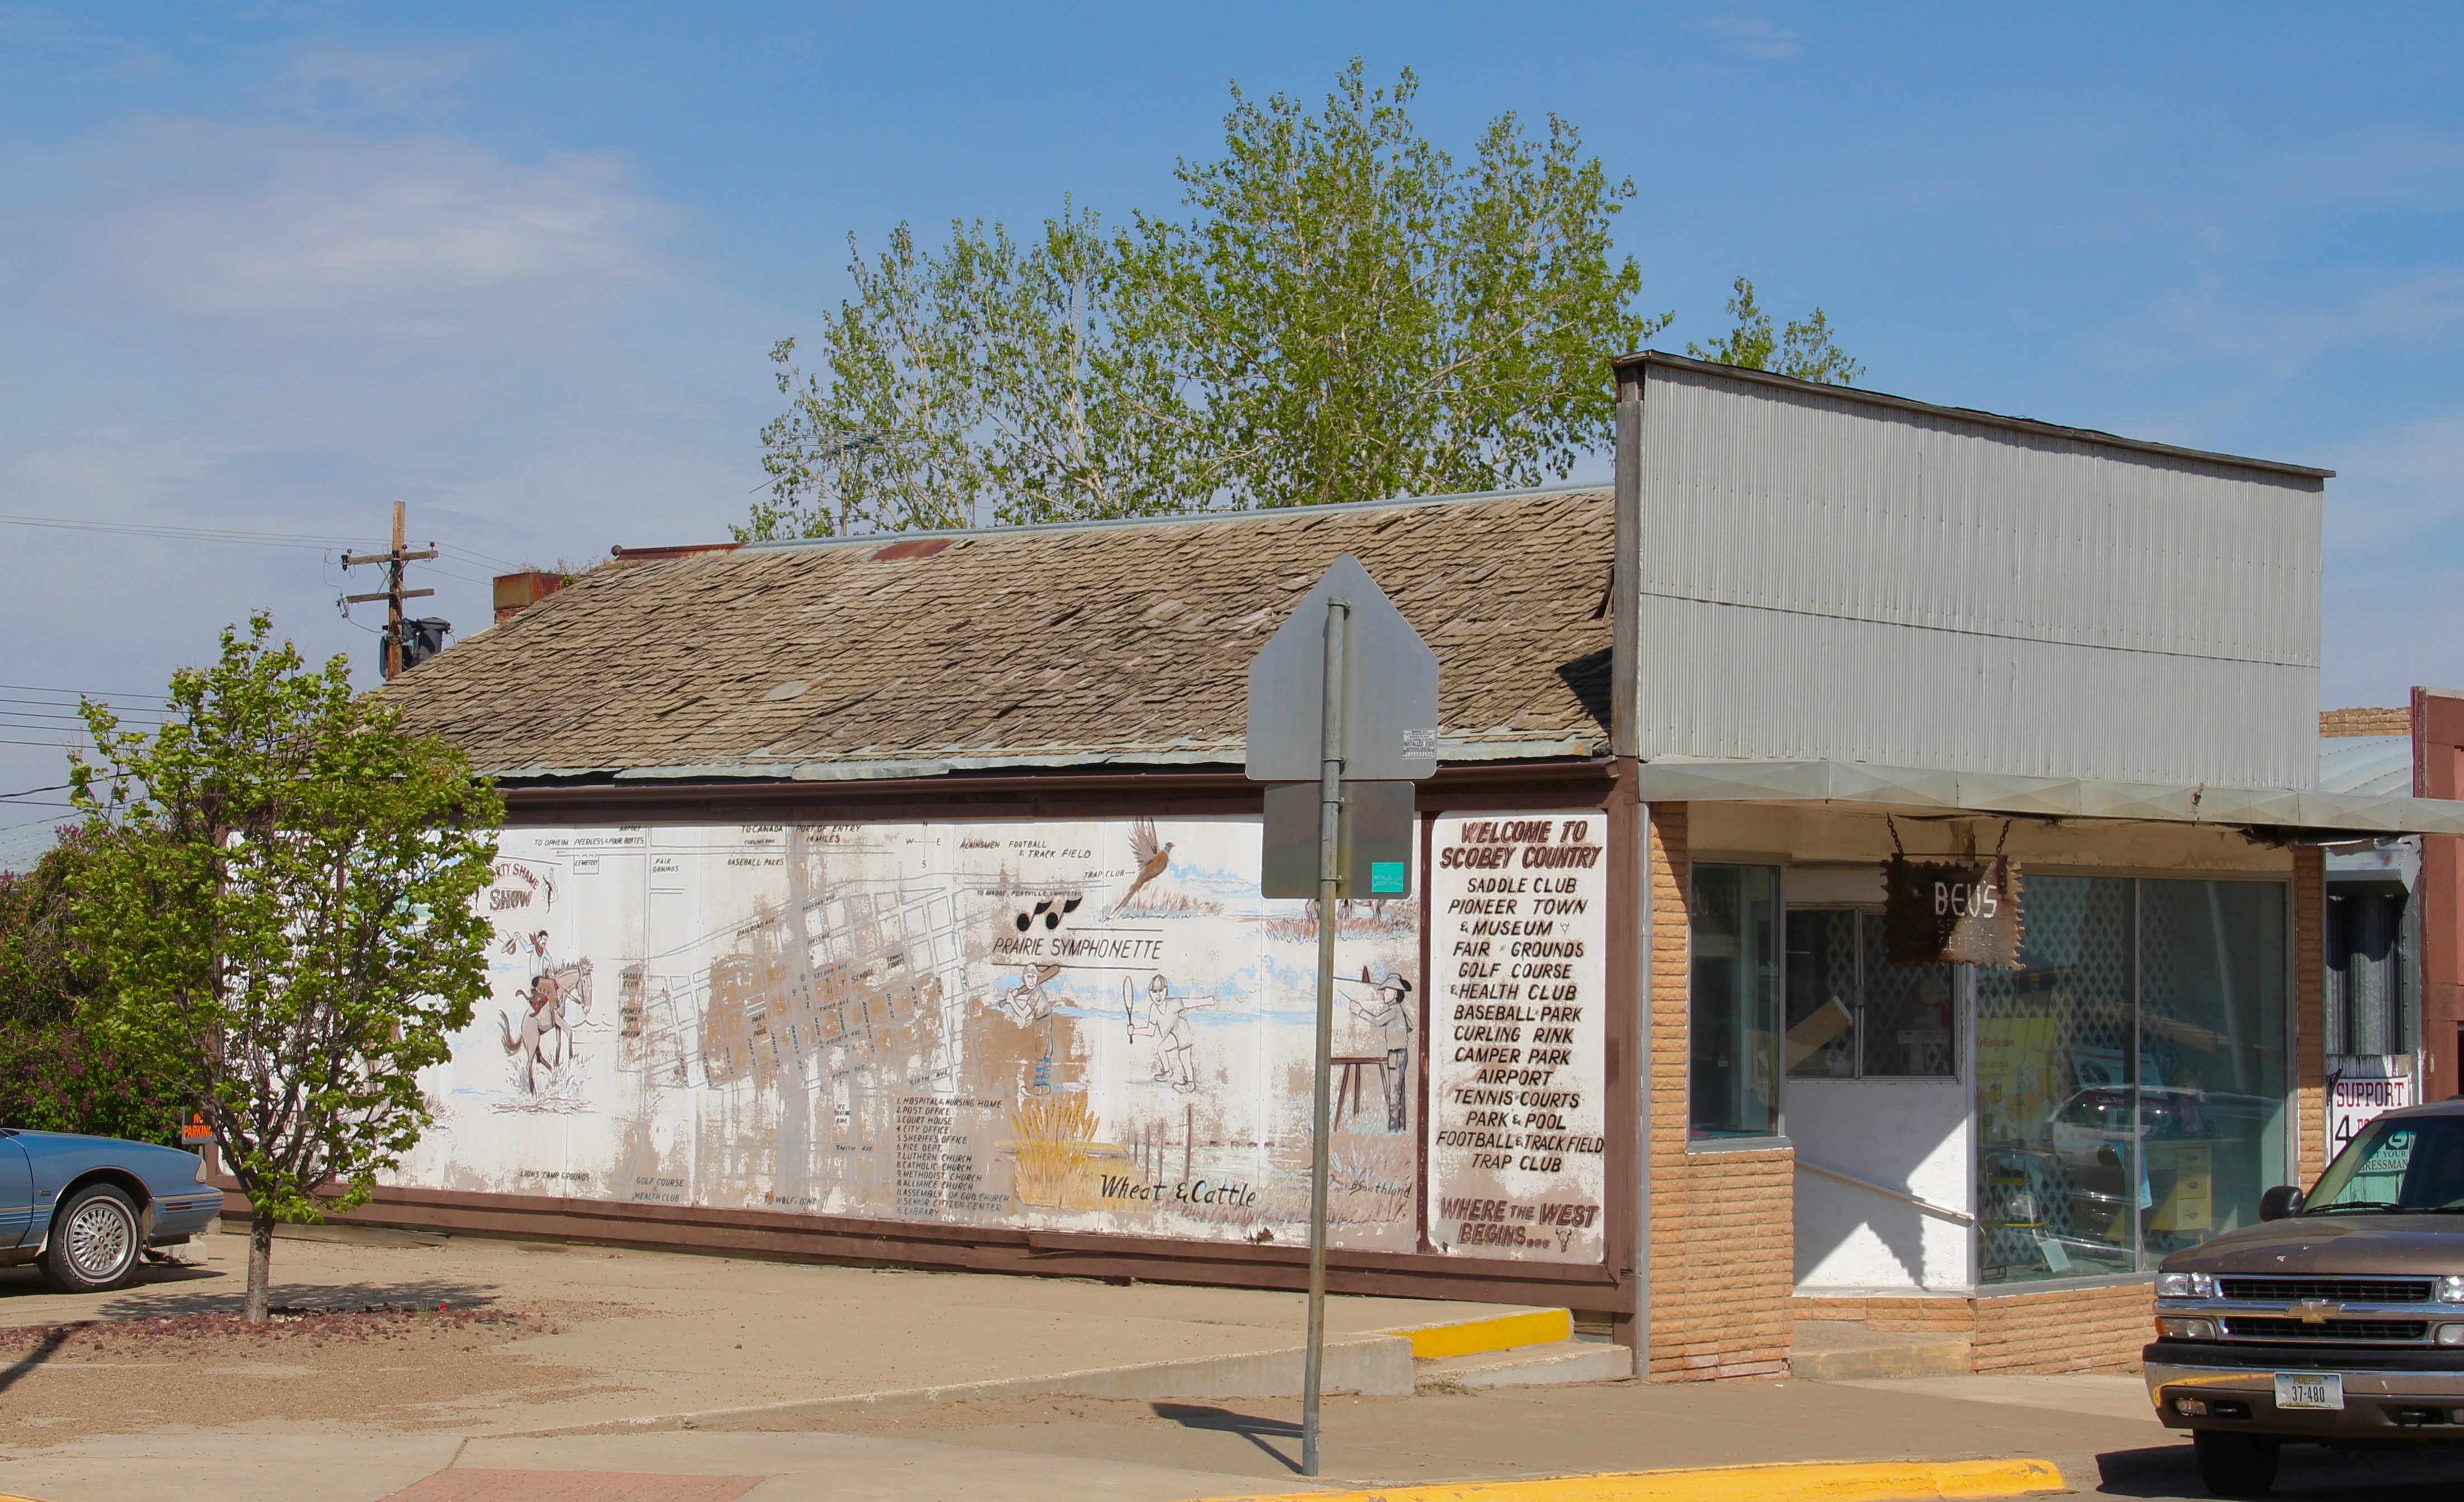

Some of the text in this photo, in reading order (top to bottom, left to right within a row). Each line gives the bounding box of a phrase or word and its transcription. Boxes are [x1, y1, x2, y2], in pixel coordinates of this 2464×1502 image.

[832, 824, 862, 833] ENTRY
[1462, 821, 1588, 843] WELCOME TO
[814, 835, 840, 843] MILES
[959, 840, 1047, 850] PLAINSMEN FOOTBALL
[1028, 850, 1057, 859] TRACK
[1062, 848, 1091, 859] FIELD
[1440, 846, 1604, 869] SCOBEY COUNTRY
[727, 857, 784, 866] BASEBALL PARKS
[922, 860, 927, 869] S
[513, 863, 540, 890] SHAME
[1467, 878, 1577, 893] SADDLE CLUB
[490, 889, 533, 911] SHOW
[1448, 899, 1588, 915] PIONEER TOWN
[736, 922, 764, 937] RAILROAD
[1460, 921, 1554, 936] & MUSEUM
[992, 938, 1163, 960] PRAIRIE SYMPHONETTE
[1453, 941, 1585, 957] FAIR GROUNDS
[813, 967, 834, 979] SECOND
[852, 969, 874, 984] SCHOOL
[1458, 962, 1573, 979] GOLF COURSE
[1450, 983, 1577, 1000] & HEALTH CLUB
[820, 1003, 836, 1013] THIRD
[1454, 1005, 1583, 1022] BASEBALL PARK
[751, 1013, 765, 1024] PARK
[754, 1028, 768, 1037] POOL
[1453, 1025, 1575, 1043] CURLING RINK
[791, 1024, 800, 1055] DANIELS
[826, 1033, 848, 1046] FOURTH
[1454, 1047, 1572, 1065] CAMPER PARK
[833, 1069, 849, 1079] FIFTH
[1477, 1069, 1553, 1086] AIRPORT
[909, 1076, 930, 1086] SIXTH
[1454, 1089, 1580, 1108] TENNIS COURTS
[2336, 1082, 2404, 1107] SUPPORT
[945, 1098, 974, 1107] NURSING
[978, 1099, 1002, 1108] HOME
[925, 1107, 949, 1116] OFFICE
[1466, 1111, 1566, 1129] PARK & POOL
[184, 1125, 212, 1138] PARKING
[923, 1126, 949, 1134] OFFICE
[2335, 1114, 2354, 1142] 4
[941, 1136, 968, 1145] OFFICE
[1436, 1131, 1604, 1153] FOOTBALL & TRACK FIELD
[922, 1144, 943, 1152] DEPT.
[2382, 1150, 2406, 1158] YOUR
[902, 1152, 972, 1163] LUTHERN CHURCH
[1472, 1153, 1562, 1172] TRAP CLUB
[902, 1161, 972, 1171] CATHOLIC CHURCH
[561, 1172, 590, 1181] GROUNDS
[902, 1170, 982, 1181] METHODIST CHURCH
[657, 1178, 684, 1187] COURSE
[902, 1180, 973, 1190] ALLIANCE CHURCH
[634, 1193, 660, 1201] HEALTH
[903, 1189, 943, 1198] ASSEMBLY
[1100, 1175, 1256, 1208] Wheat & Cattle
[764, 1195, 774, 1204] TO
[904, 1198, 1001, 1212] SENIOR CITIZEN CENTER
[905, 1207, 939, 1215] LIBRARY
[1440, 1197, 1600, 1227] WHERE THE WEST
